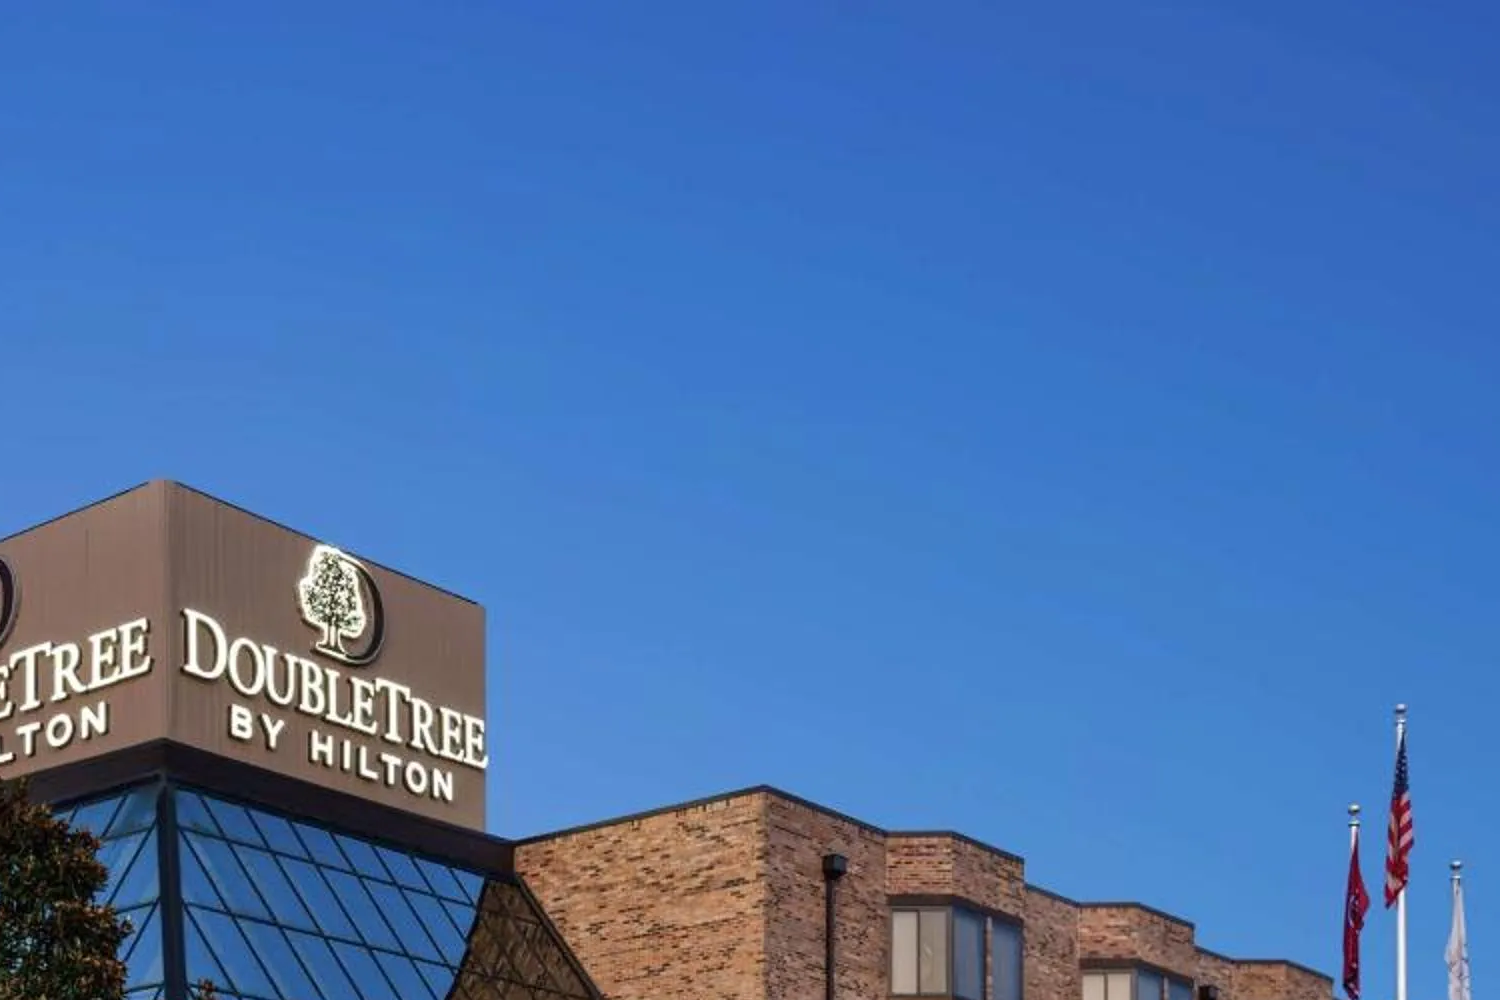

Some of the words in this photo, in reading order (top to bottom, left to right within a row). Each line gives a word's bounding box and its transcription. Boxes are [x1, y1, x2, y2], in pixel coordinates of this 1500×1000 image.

[183, 608, 489, 770] DOUBLETREE
[228, 703, 285, 751] BY
[308, 729, 454, 801] HILTON
